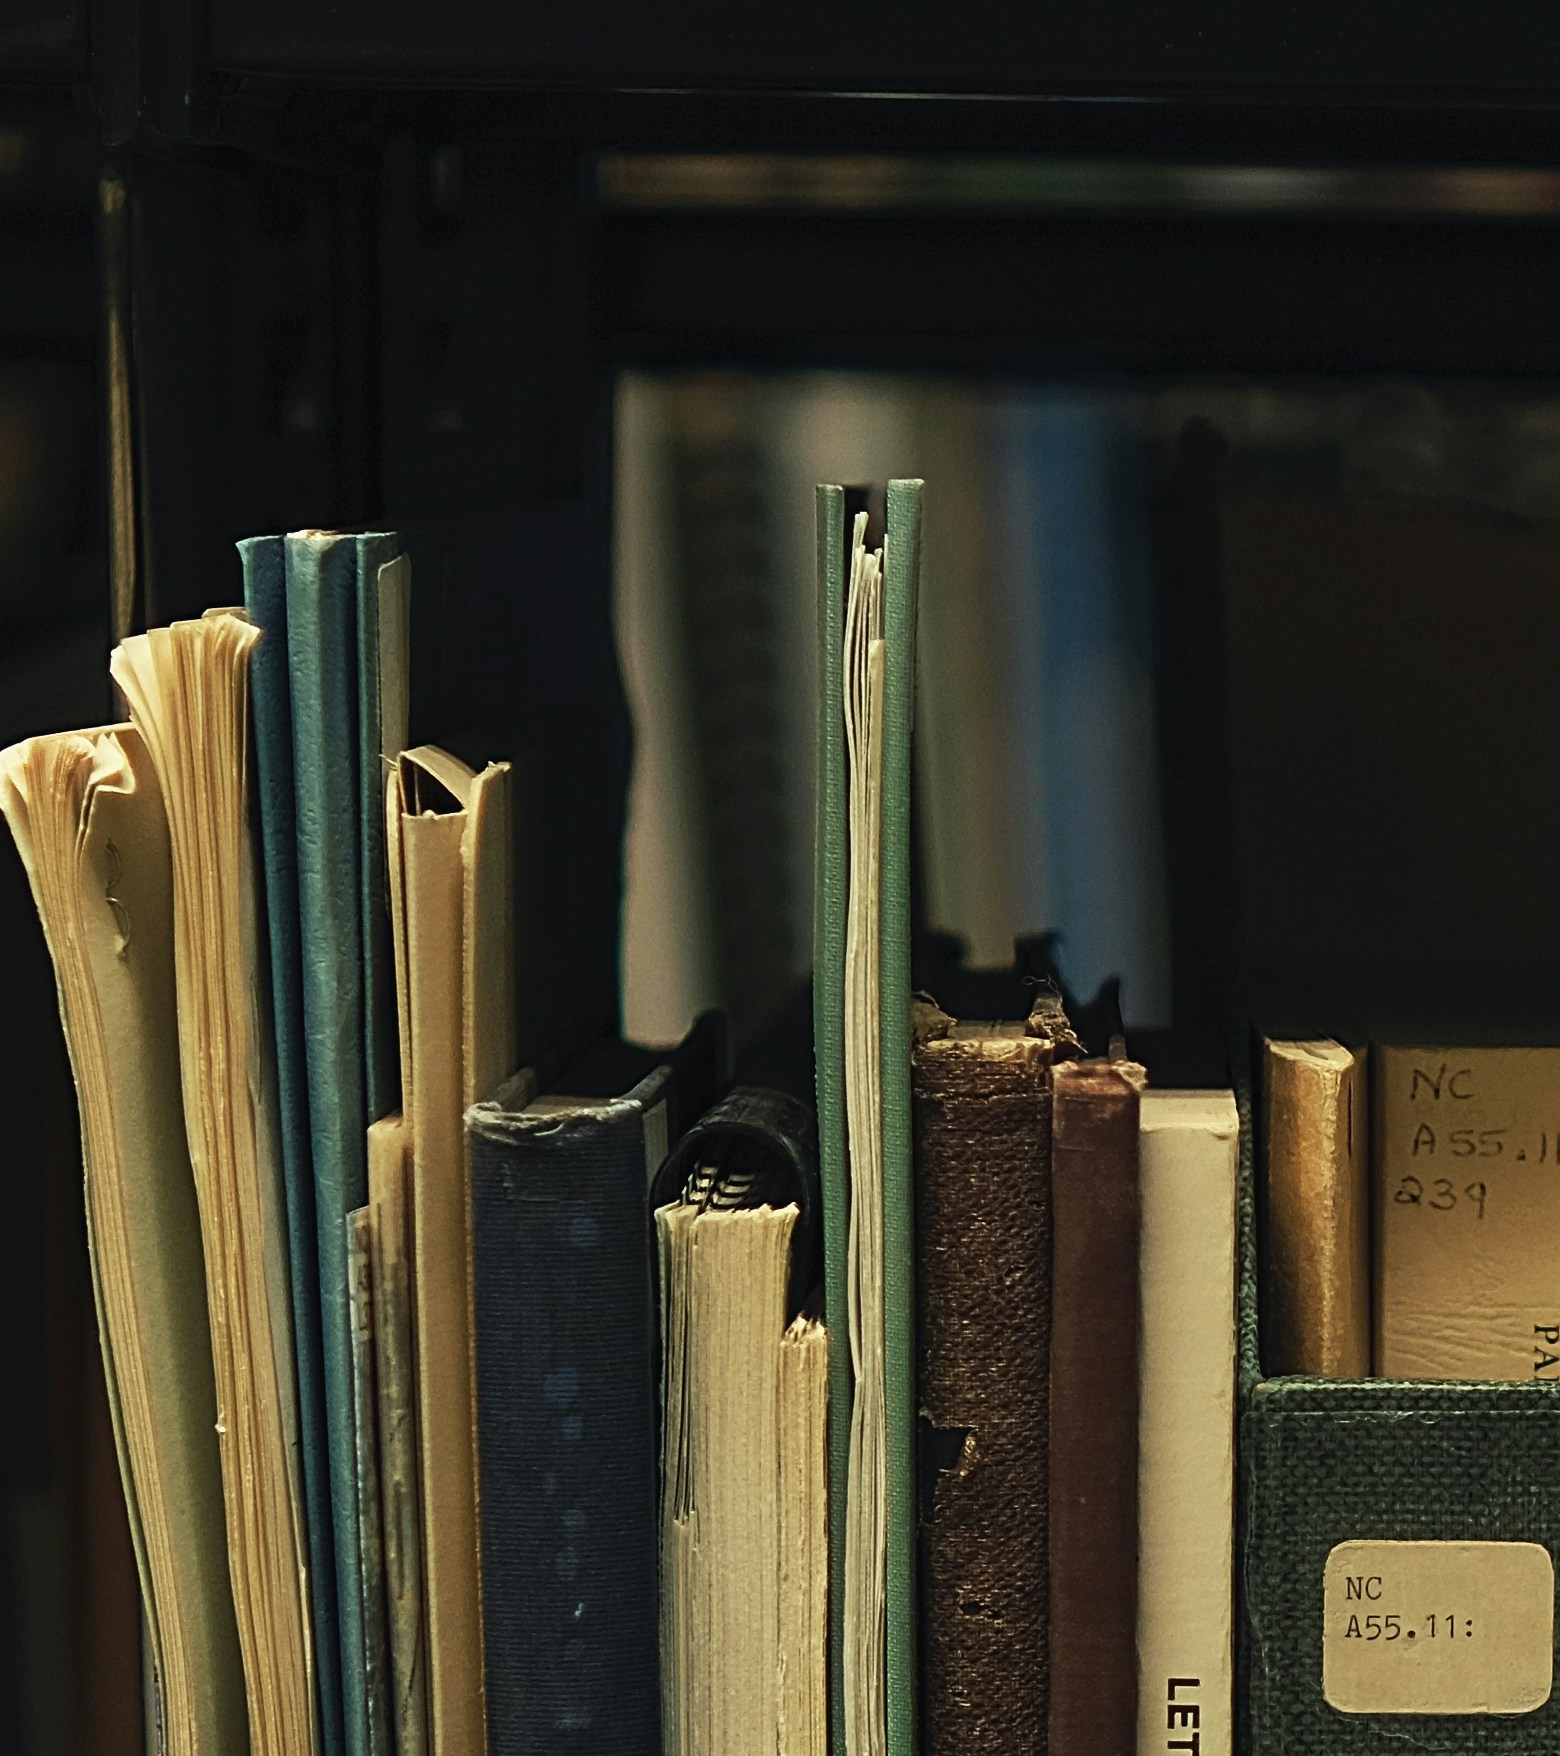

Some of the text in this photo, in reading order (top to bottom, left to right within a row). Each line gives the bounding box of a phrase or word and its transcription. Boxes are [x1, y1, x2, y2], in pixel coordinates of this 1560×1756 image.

[1410, 1063, 1475, 1100] NC
[1394, 1175, 1487, 1220] 239
[1534, 1324, 1560, 1382] PA
[1345, 1576, 1383, 1601] NC
[1344, 1614, 1473, 1641] A55.11:
